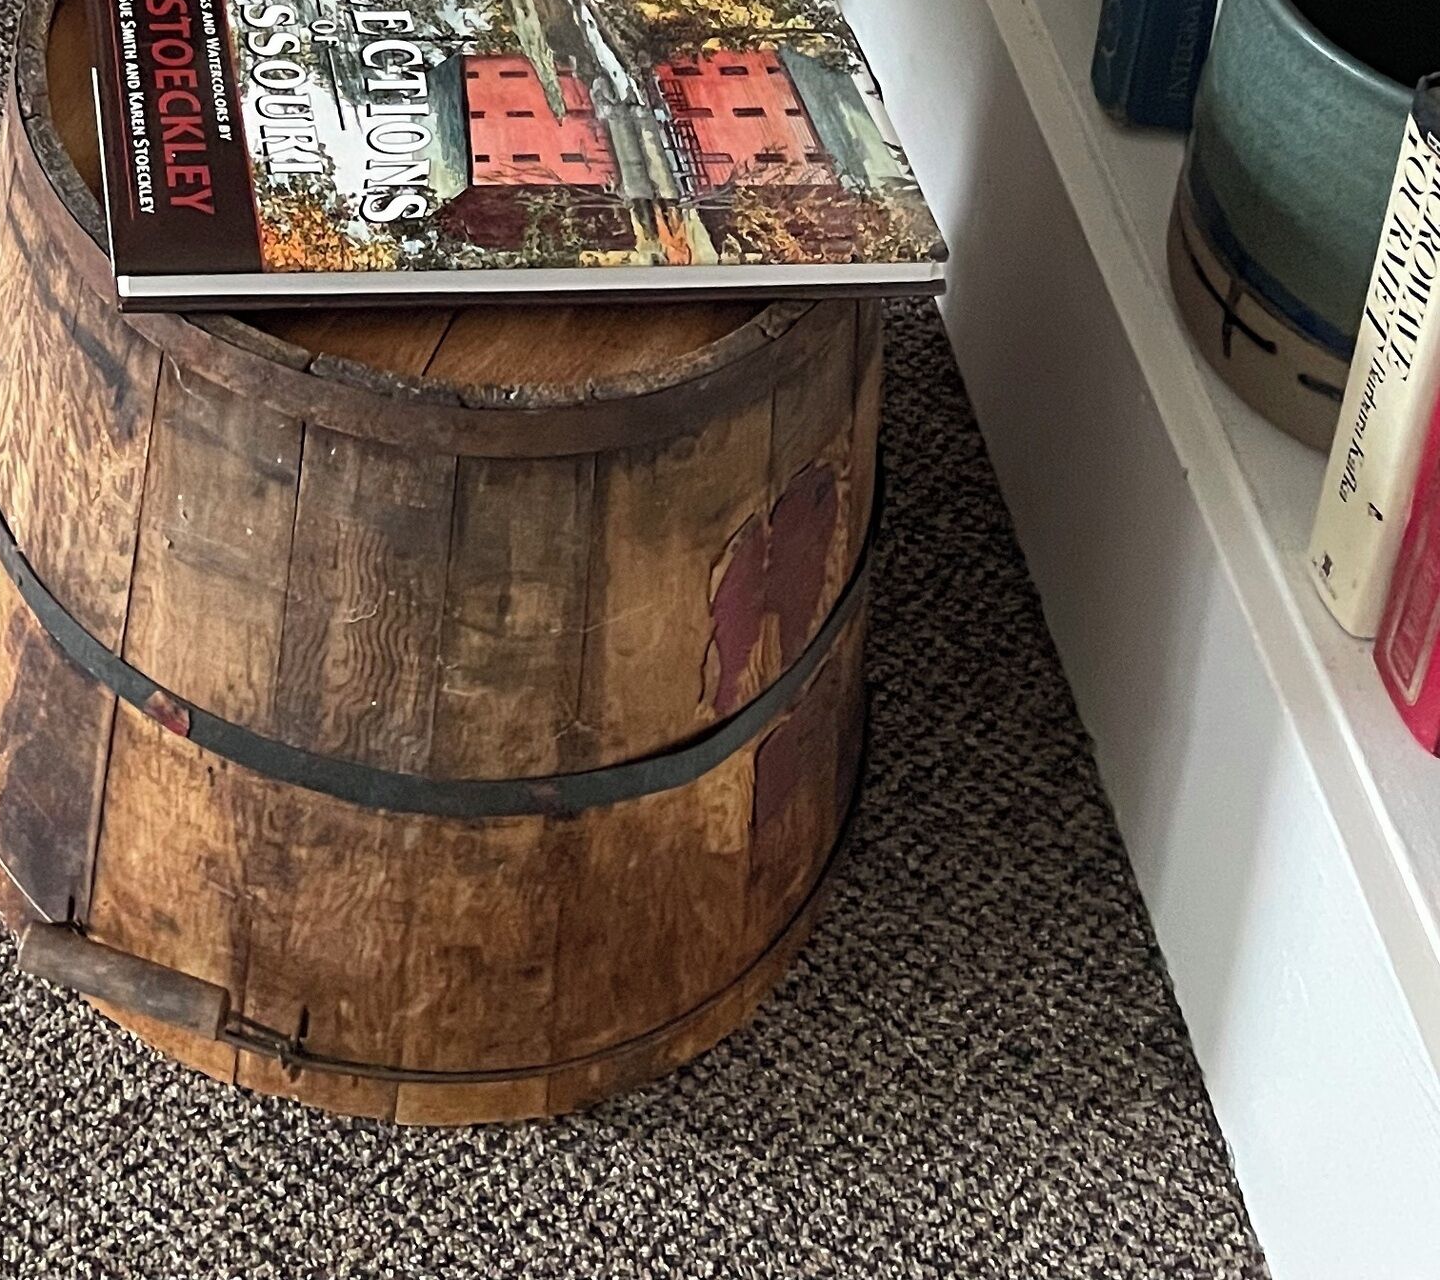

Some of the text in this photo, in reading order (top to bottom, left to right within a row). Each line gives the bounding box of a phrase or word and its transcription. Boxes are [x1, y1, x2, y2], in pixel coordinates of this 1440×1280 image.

[120, 20, 138, 60] SMITH
[201, 10, 216, 36] AND
[309, 18, 341, 47] OF
[125, 62, 141, 90] AND
[206, 37, 230, 123] WATERCOLORS
[127, 91, 146, 137] KAREN
[217, 124, 233, 141] BY
[132, 137, 156, 215] STOECKLEY
[1337, 355, 1388, 505] Barbara Kafka
